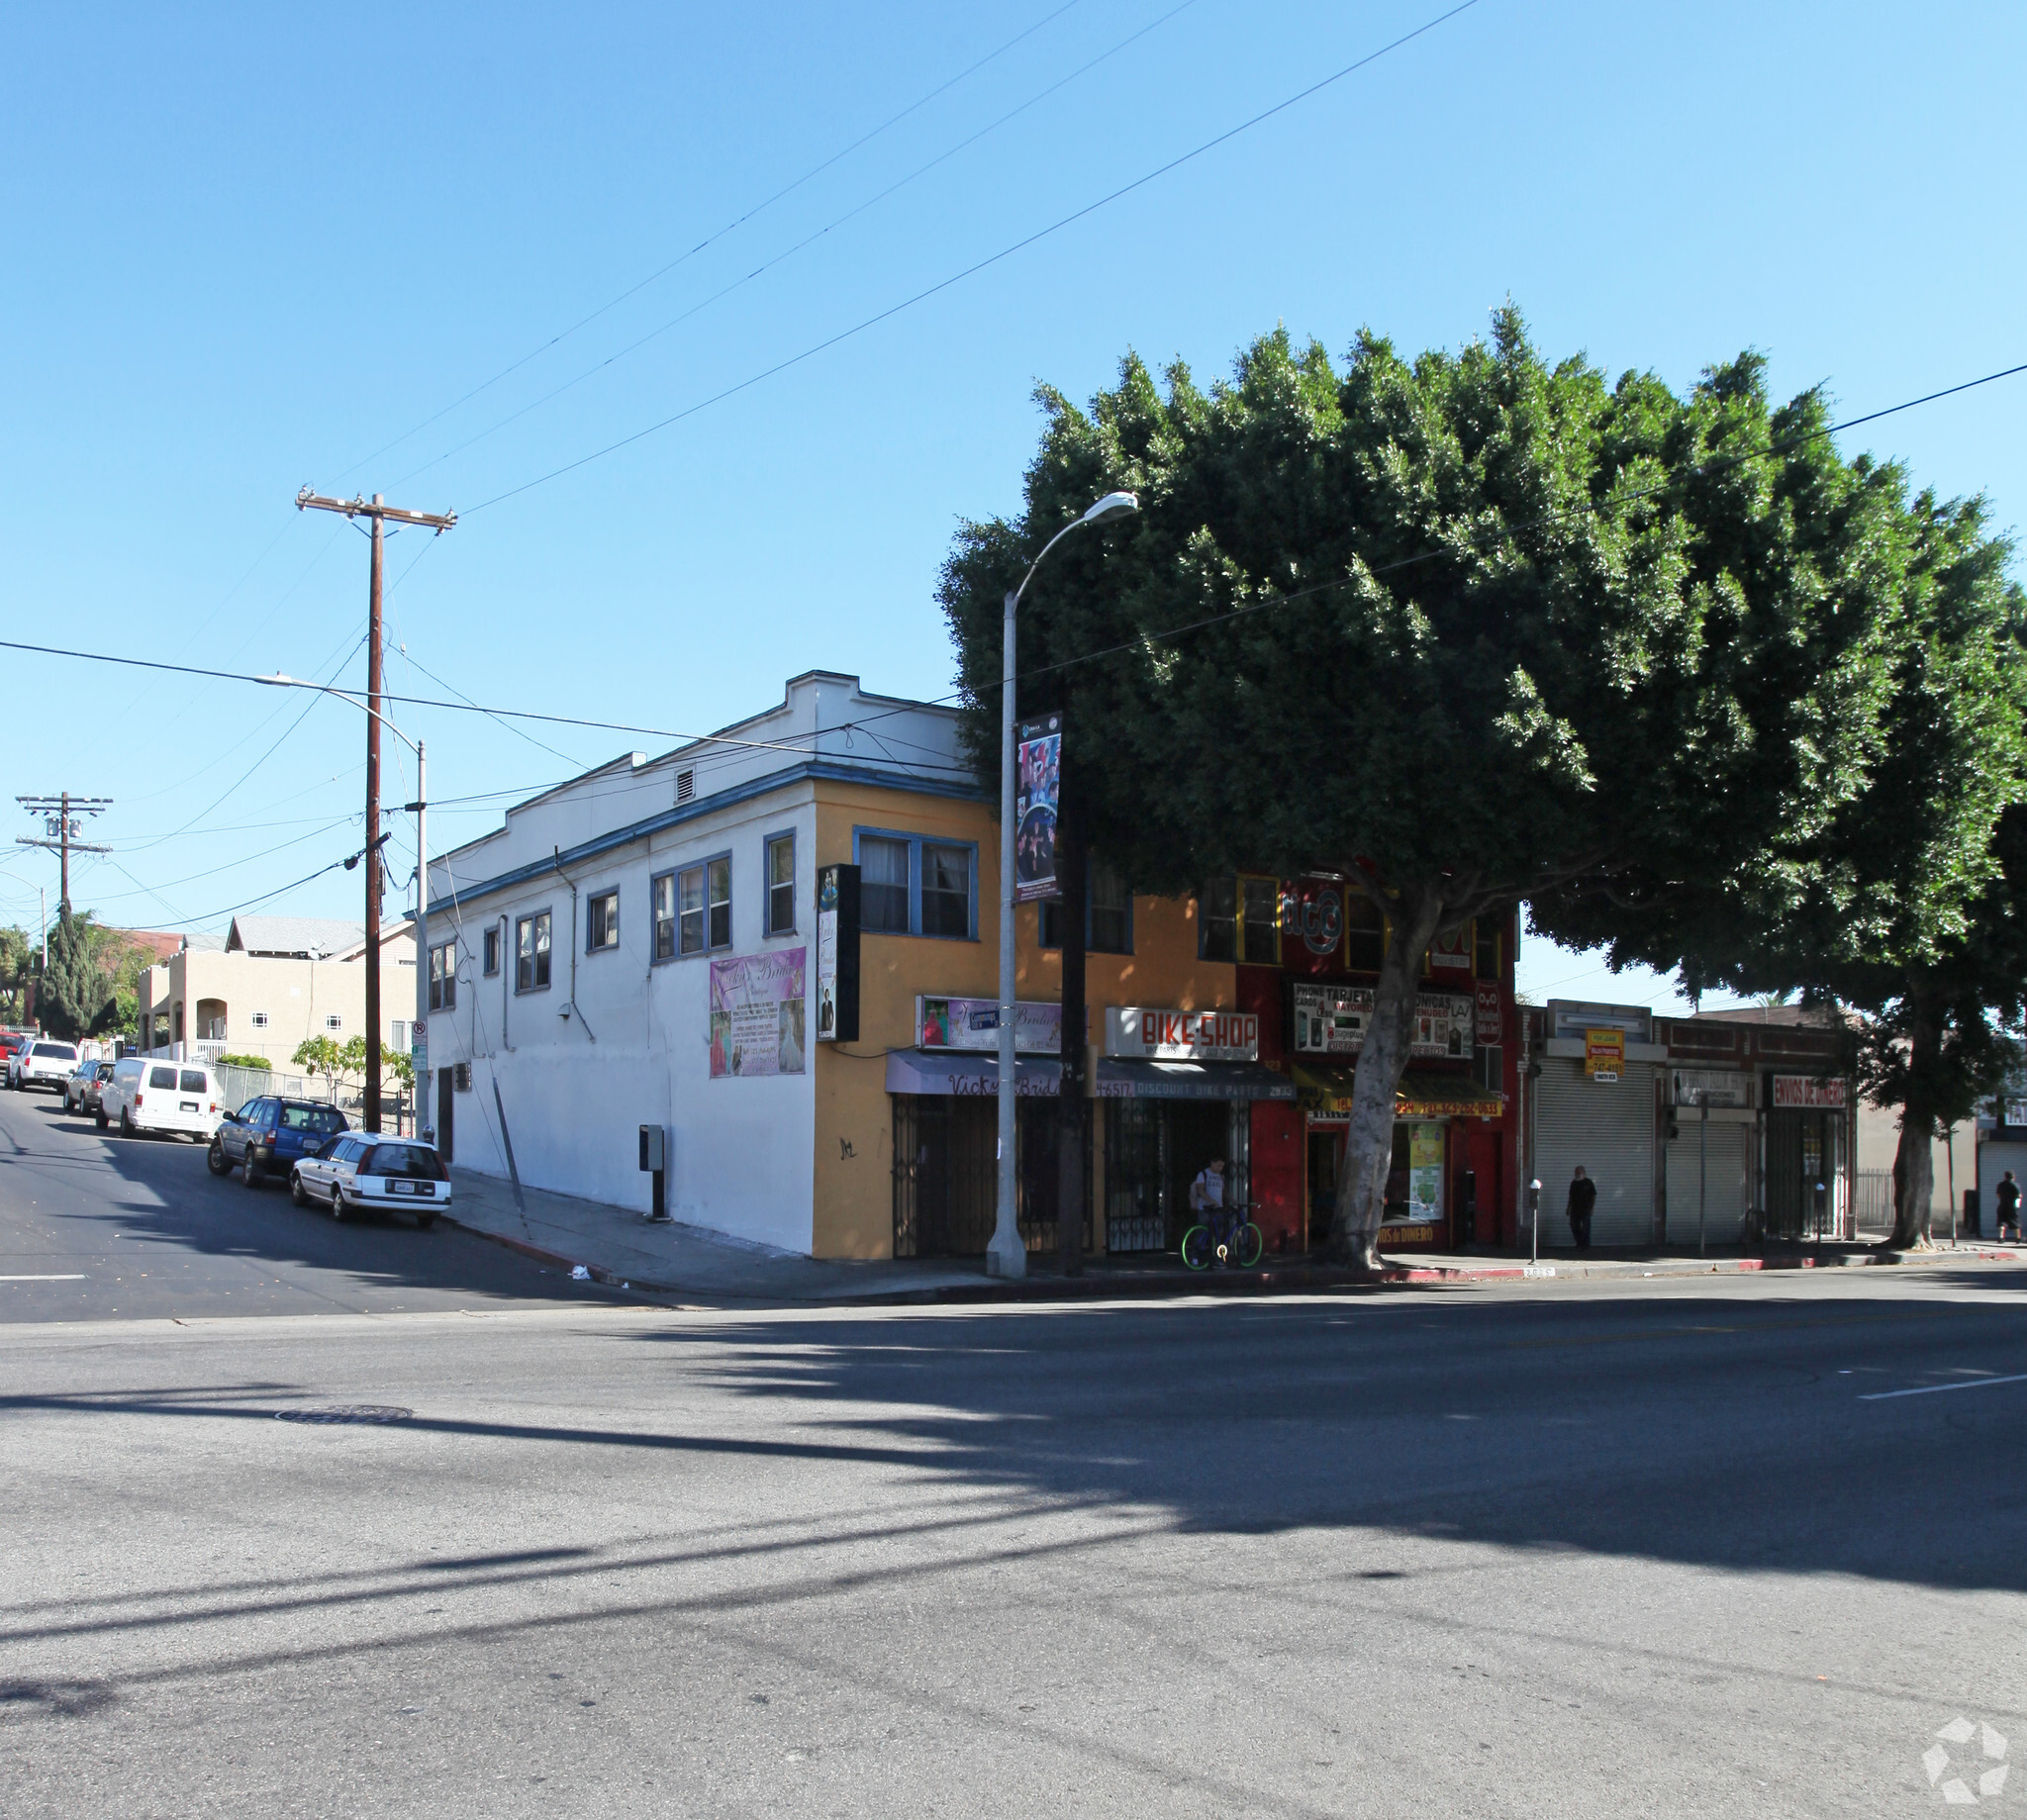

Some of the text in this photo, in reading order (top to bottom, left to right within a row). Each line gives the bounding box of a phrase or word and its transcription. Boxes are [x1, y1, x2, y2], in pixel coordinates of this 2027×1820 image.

[1296, 998, 1317, 1007] CARDS
[1333, 1002, 1373, 1013] MAYOREO
[1297, 986, 1324, 997] PHONE
[1415, 995, 1450, 1009] ONICAS
[1317, 1011, 1333, 1020] LESS
[1142, 1012, 1255, 1047] BIKE SHOP
[949, 1076, 1000, 1096] Vicky
[1137, 1083, 1190, 1095] DISCOUNT
[1196, 1085, 1219, 1096] BIKE
[1225, 1086, 1259, 1096] PARTS
[1775, 1078, 1802, 1104] ENVIOS
[1401, 1226, 1433, 1243] DINERO
